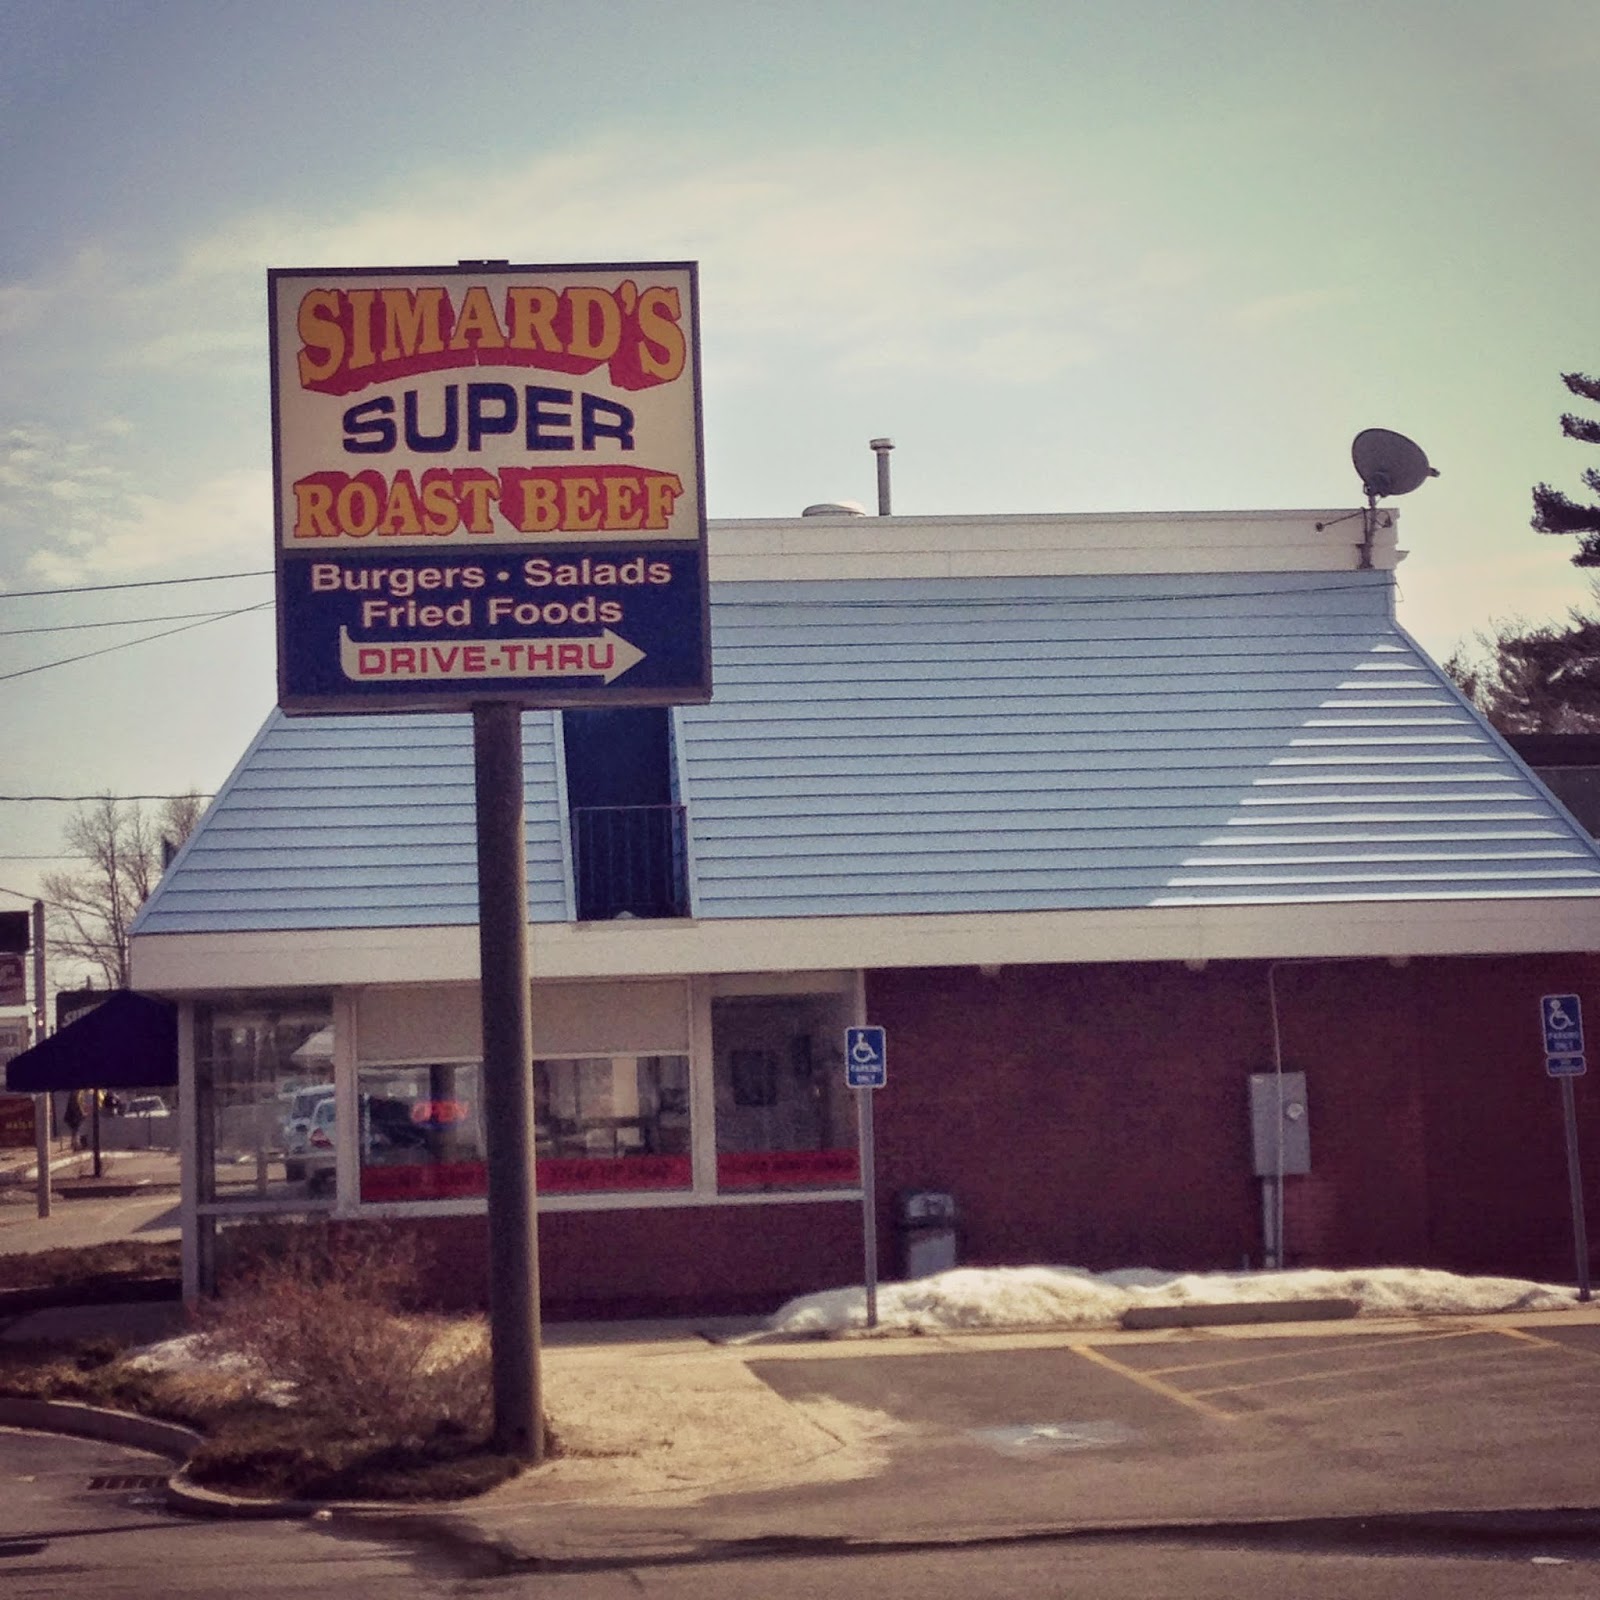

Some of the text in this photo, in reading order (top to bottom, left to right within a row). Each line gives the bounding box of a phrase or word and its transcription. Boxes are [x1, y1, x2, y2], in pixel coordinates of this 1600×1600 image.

[297, 279, 686, 395] SIMARD'S
[342, 383, 635, 453] SUPER
[293, 466, 684, 538] ROAST BEEF
[311, 557, 672, 596] Burgers Salads
[362, 596, 623, 628] Fried Foods
[358, 643, 615, 675] DRIVE-THRU
